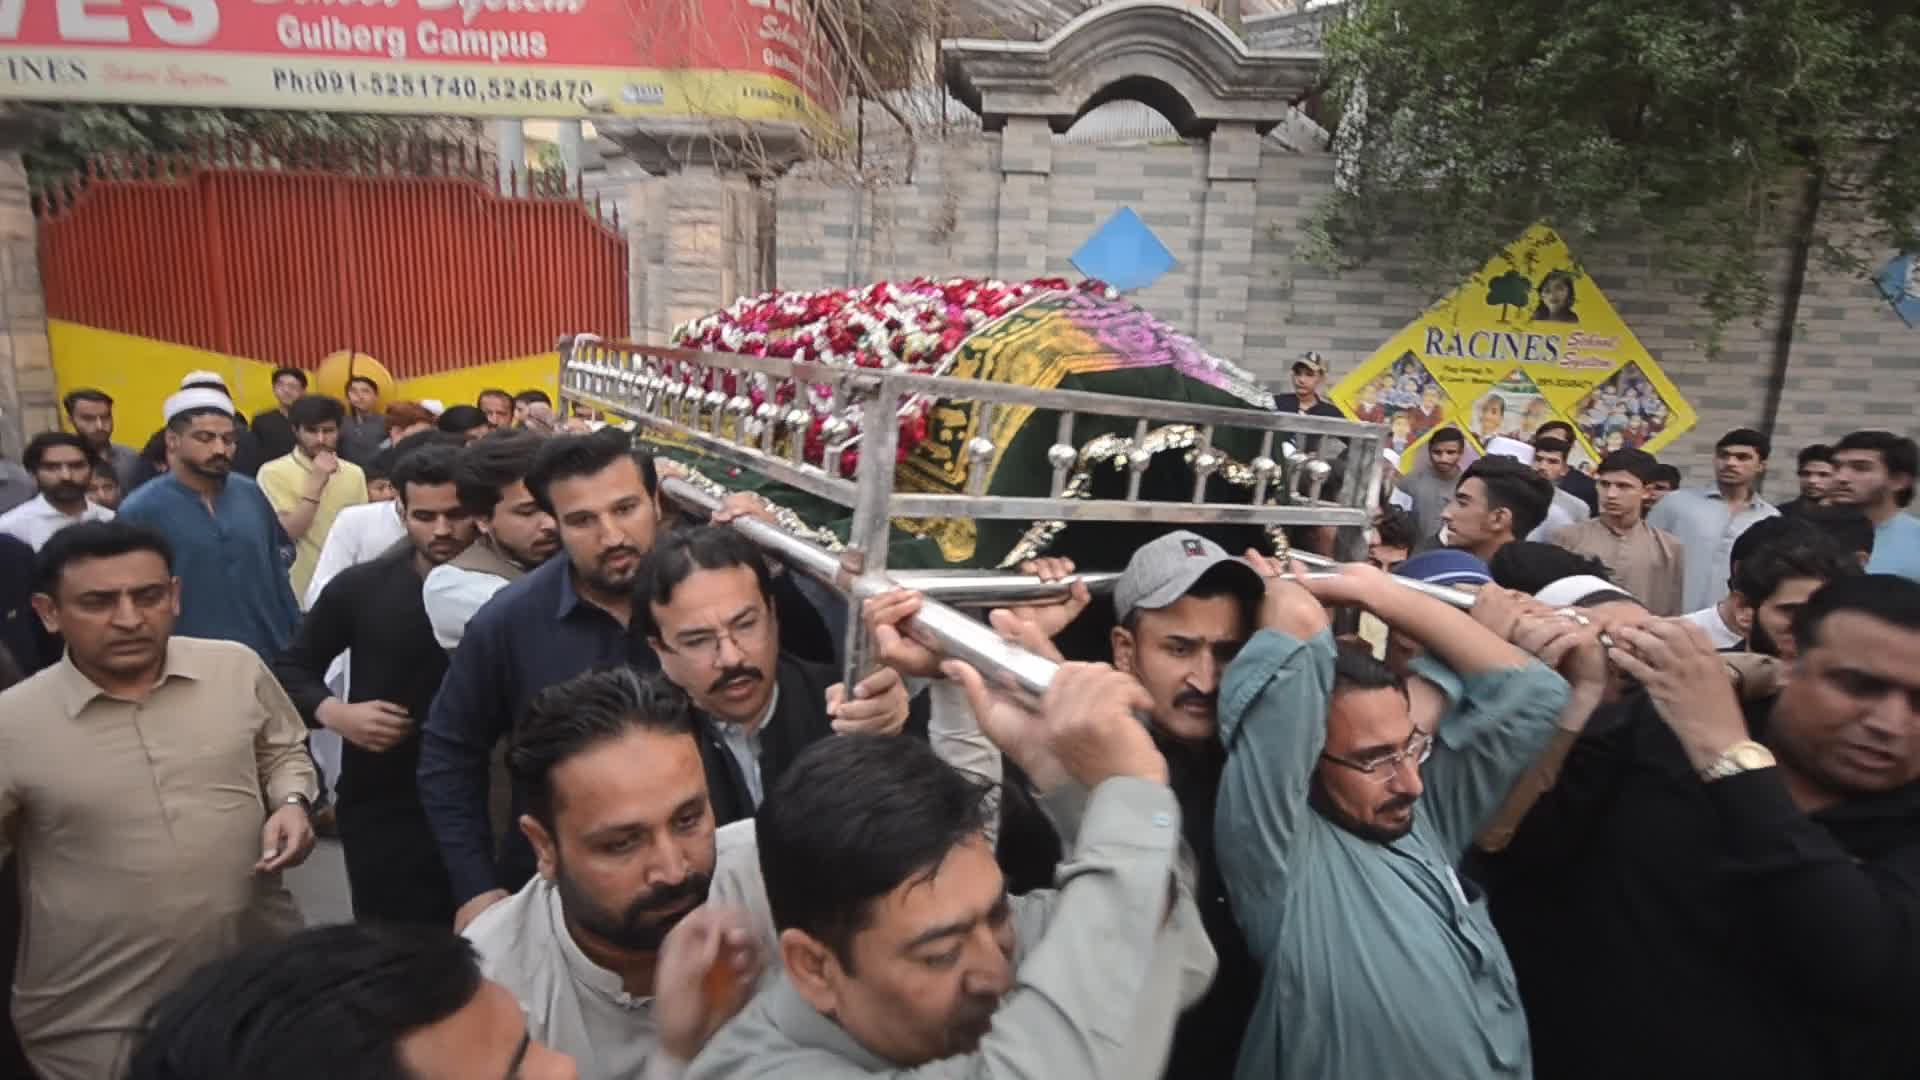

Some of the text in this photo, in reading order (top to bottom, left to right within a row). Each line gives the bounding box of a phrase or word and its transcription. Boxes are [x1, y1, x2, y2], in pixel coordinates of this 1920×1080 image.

[277, 14, 548, 63] Gulberg Campus
[0, 54, 88, 84] INES
[1425, 326, 1561, 362] RACINES
